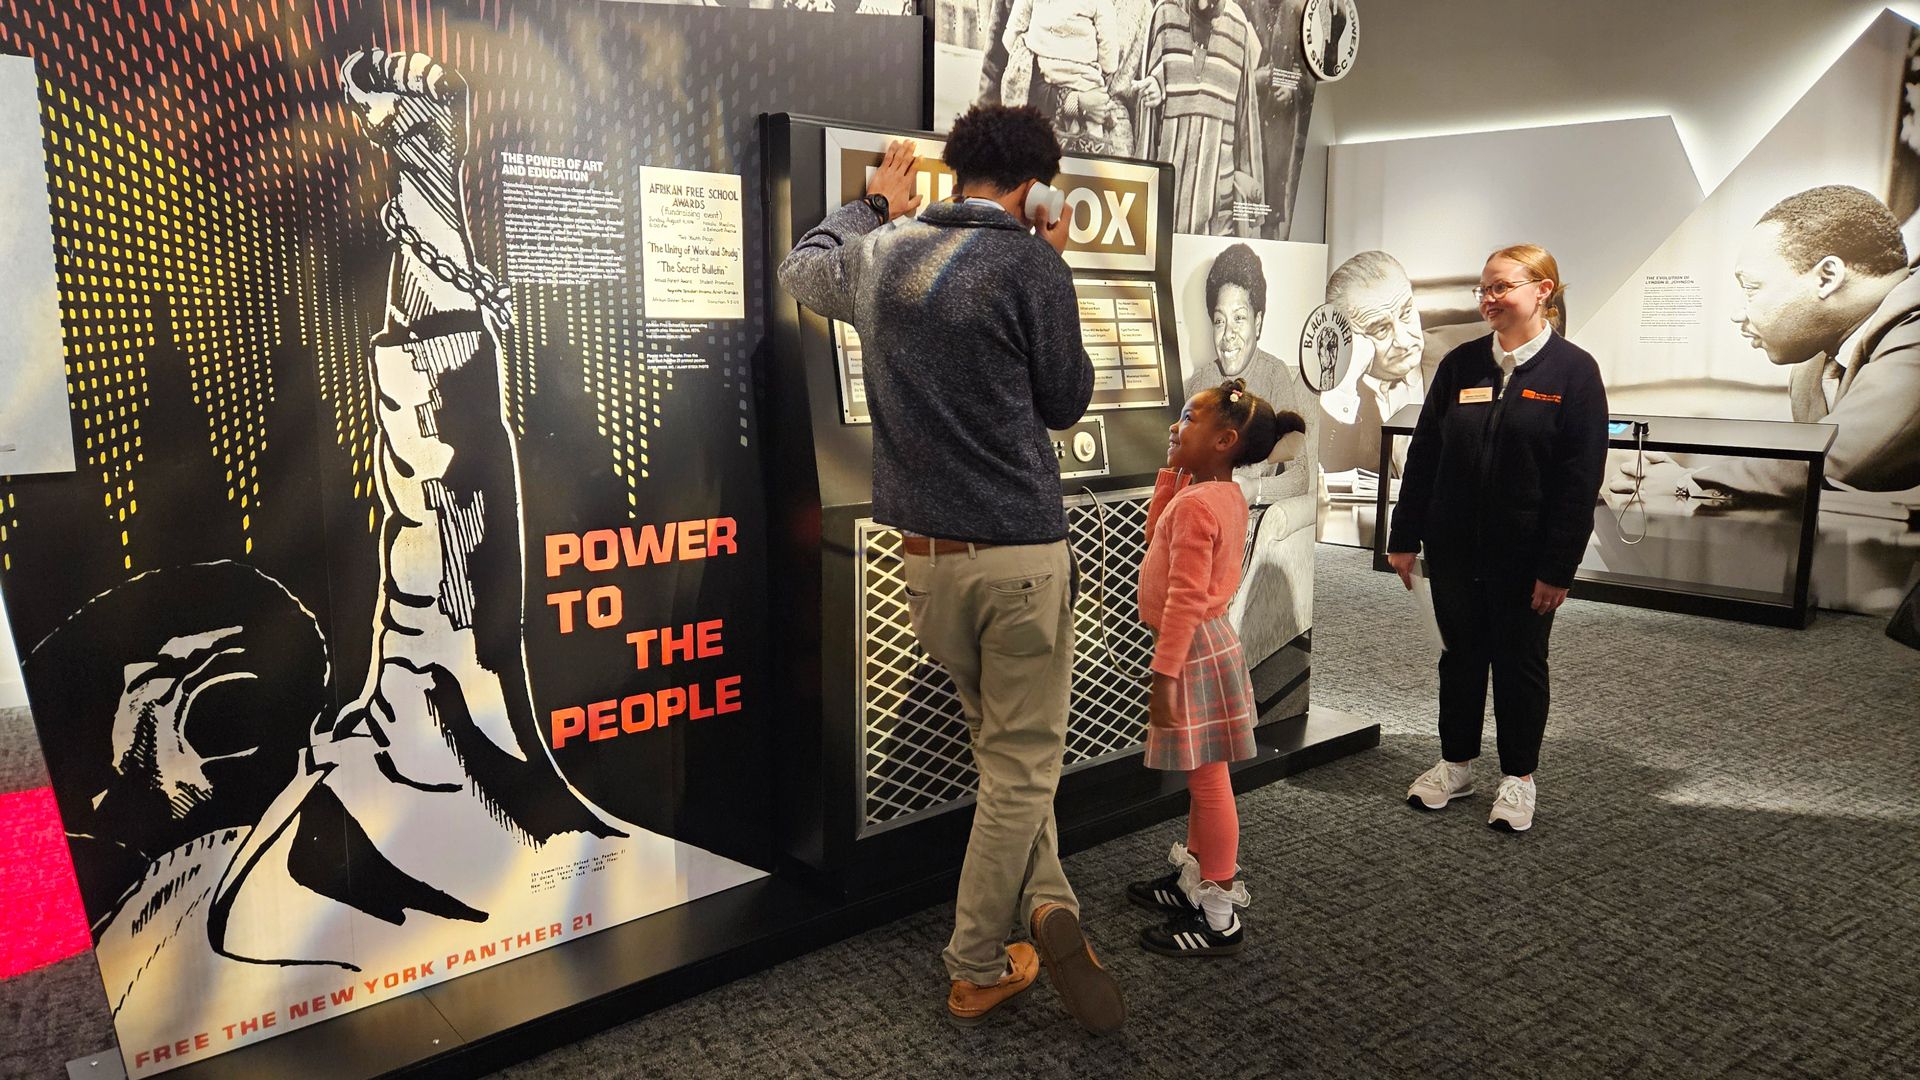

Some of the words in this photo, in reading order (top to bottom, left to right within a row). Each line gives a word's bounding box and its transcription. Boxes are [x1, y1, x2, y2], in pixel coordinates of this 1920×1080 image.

[1306, 0, 1320, 45] BLAC
[500, 151, 525, 165] THE
[525, 154, 565, 168] POWER
[566, 158, 581, 169] OF
[582, 160, 604, 172] ART
[501, 163, 526, 177] AND
[527, 166, 589, 182] EDUCATION
[648, 183, 683, 196] AFRIKAN
[685, 186, 705, 198] FREE
[708, 188, 739, 201] SCHOOL
[672, 198, 706, 210] AWARDS
[703, 209, 723, 220] event)
[664, 243, 683, 258] Unity
[683, 245, 691, 255] of
[691, 245, 710, 256] Work
[710, 247, 720, 257] and
[676, 262, 700, 274] Secret
[1304, 312, 1328, 349] BLACK
[1331, 310, 1353, 347] POWER
[545, 516, 737, 577] POWER
[546, 585, 623, 634] TO
[626, 618, 724, 670] THE
[551, 674, 742, 749] PEOPLE
[135, 1032, 210, 1069] FREE
[222, 1011, 277, 1041] THE
[288, 986, 355, 1020] NEW
[364, 961, 434, 994] YORK
[446, 922, 563, 970] PANTHER
[572, 912, 593, 932] 21
